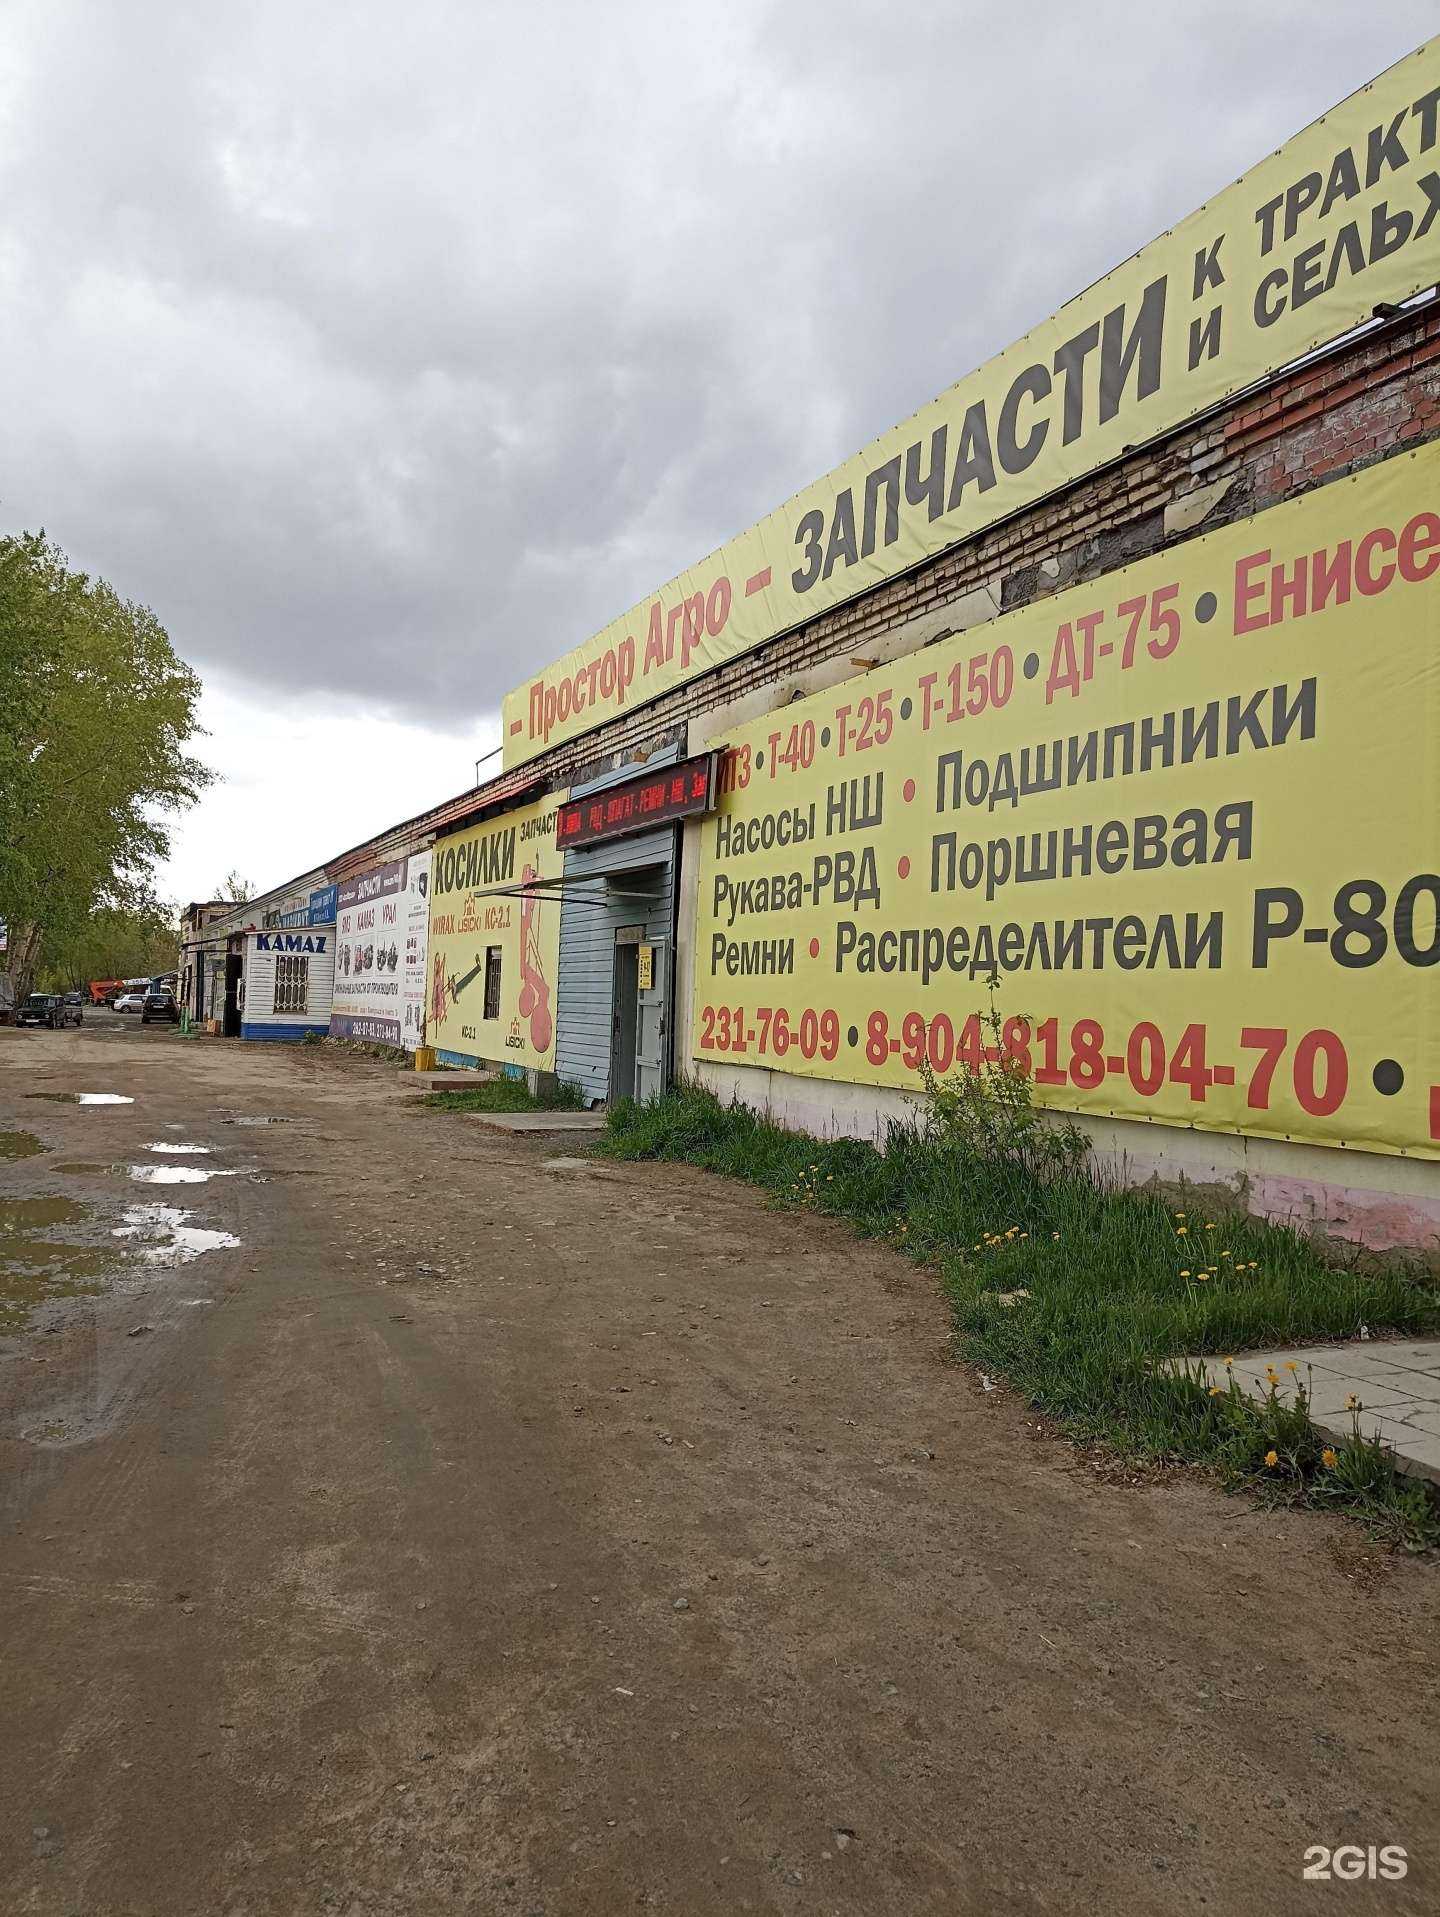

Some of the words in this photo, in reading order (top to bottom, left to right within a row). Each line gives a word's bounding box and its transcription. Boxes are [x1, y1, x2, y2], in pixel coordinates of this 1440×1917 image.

[1255, 86, 1440, 257] ТРАКТ
[529, 636, 635, 744] Простор
[643, 576, 731, 676] Агро
[791, 274, 1168, 594] ЗАПЧАСТИ
[768, 718, 816, 778] Т-40
[835, 688, 894, 757] Т-25
[918, 645, 1014, 730] Т-150
[1045, 582, 1181, 705] ДТ-75
[1233, 512, 1440, 636] Енисе
[716, 803, 816, 859] Насосы
[826, 771, 884, 836] НШ
[936, 676, 1317, 813] Подшипники
[435, 827, 516, 895] КОСИЛКИ
[520, 811, 557, 842] ЗАПЧАСТ
[713, 846, 881, 927] Рукава-РВД
[930, 800, 1254, 901] Поршневая
[711, 932, 795, 976] Ремни
[835, 911, 1224, 986] Распределители
[1252, 874, 1440, 968] Р-80
[700, 1005, 840, 1062] 231-76-09
[866, 1010, 1349, 1117] 8-904-818-04-70
